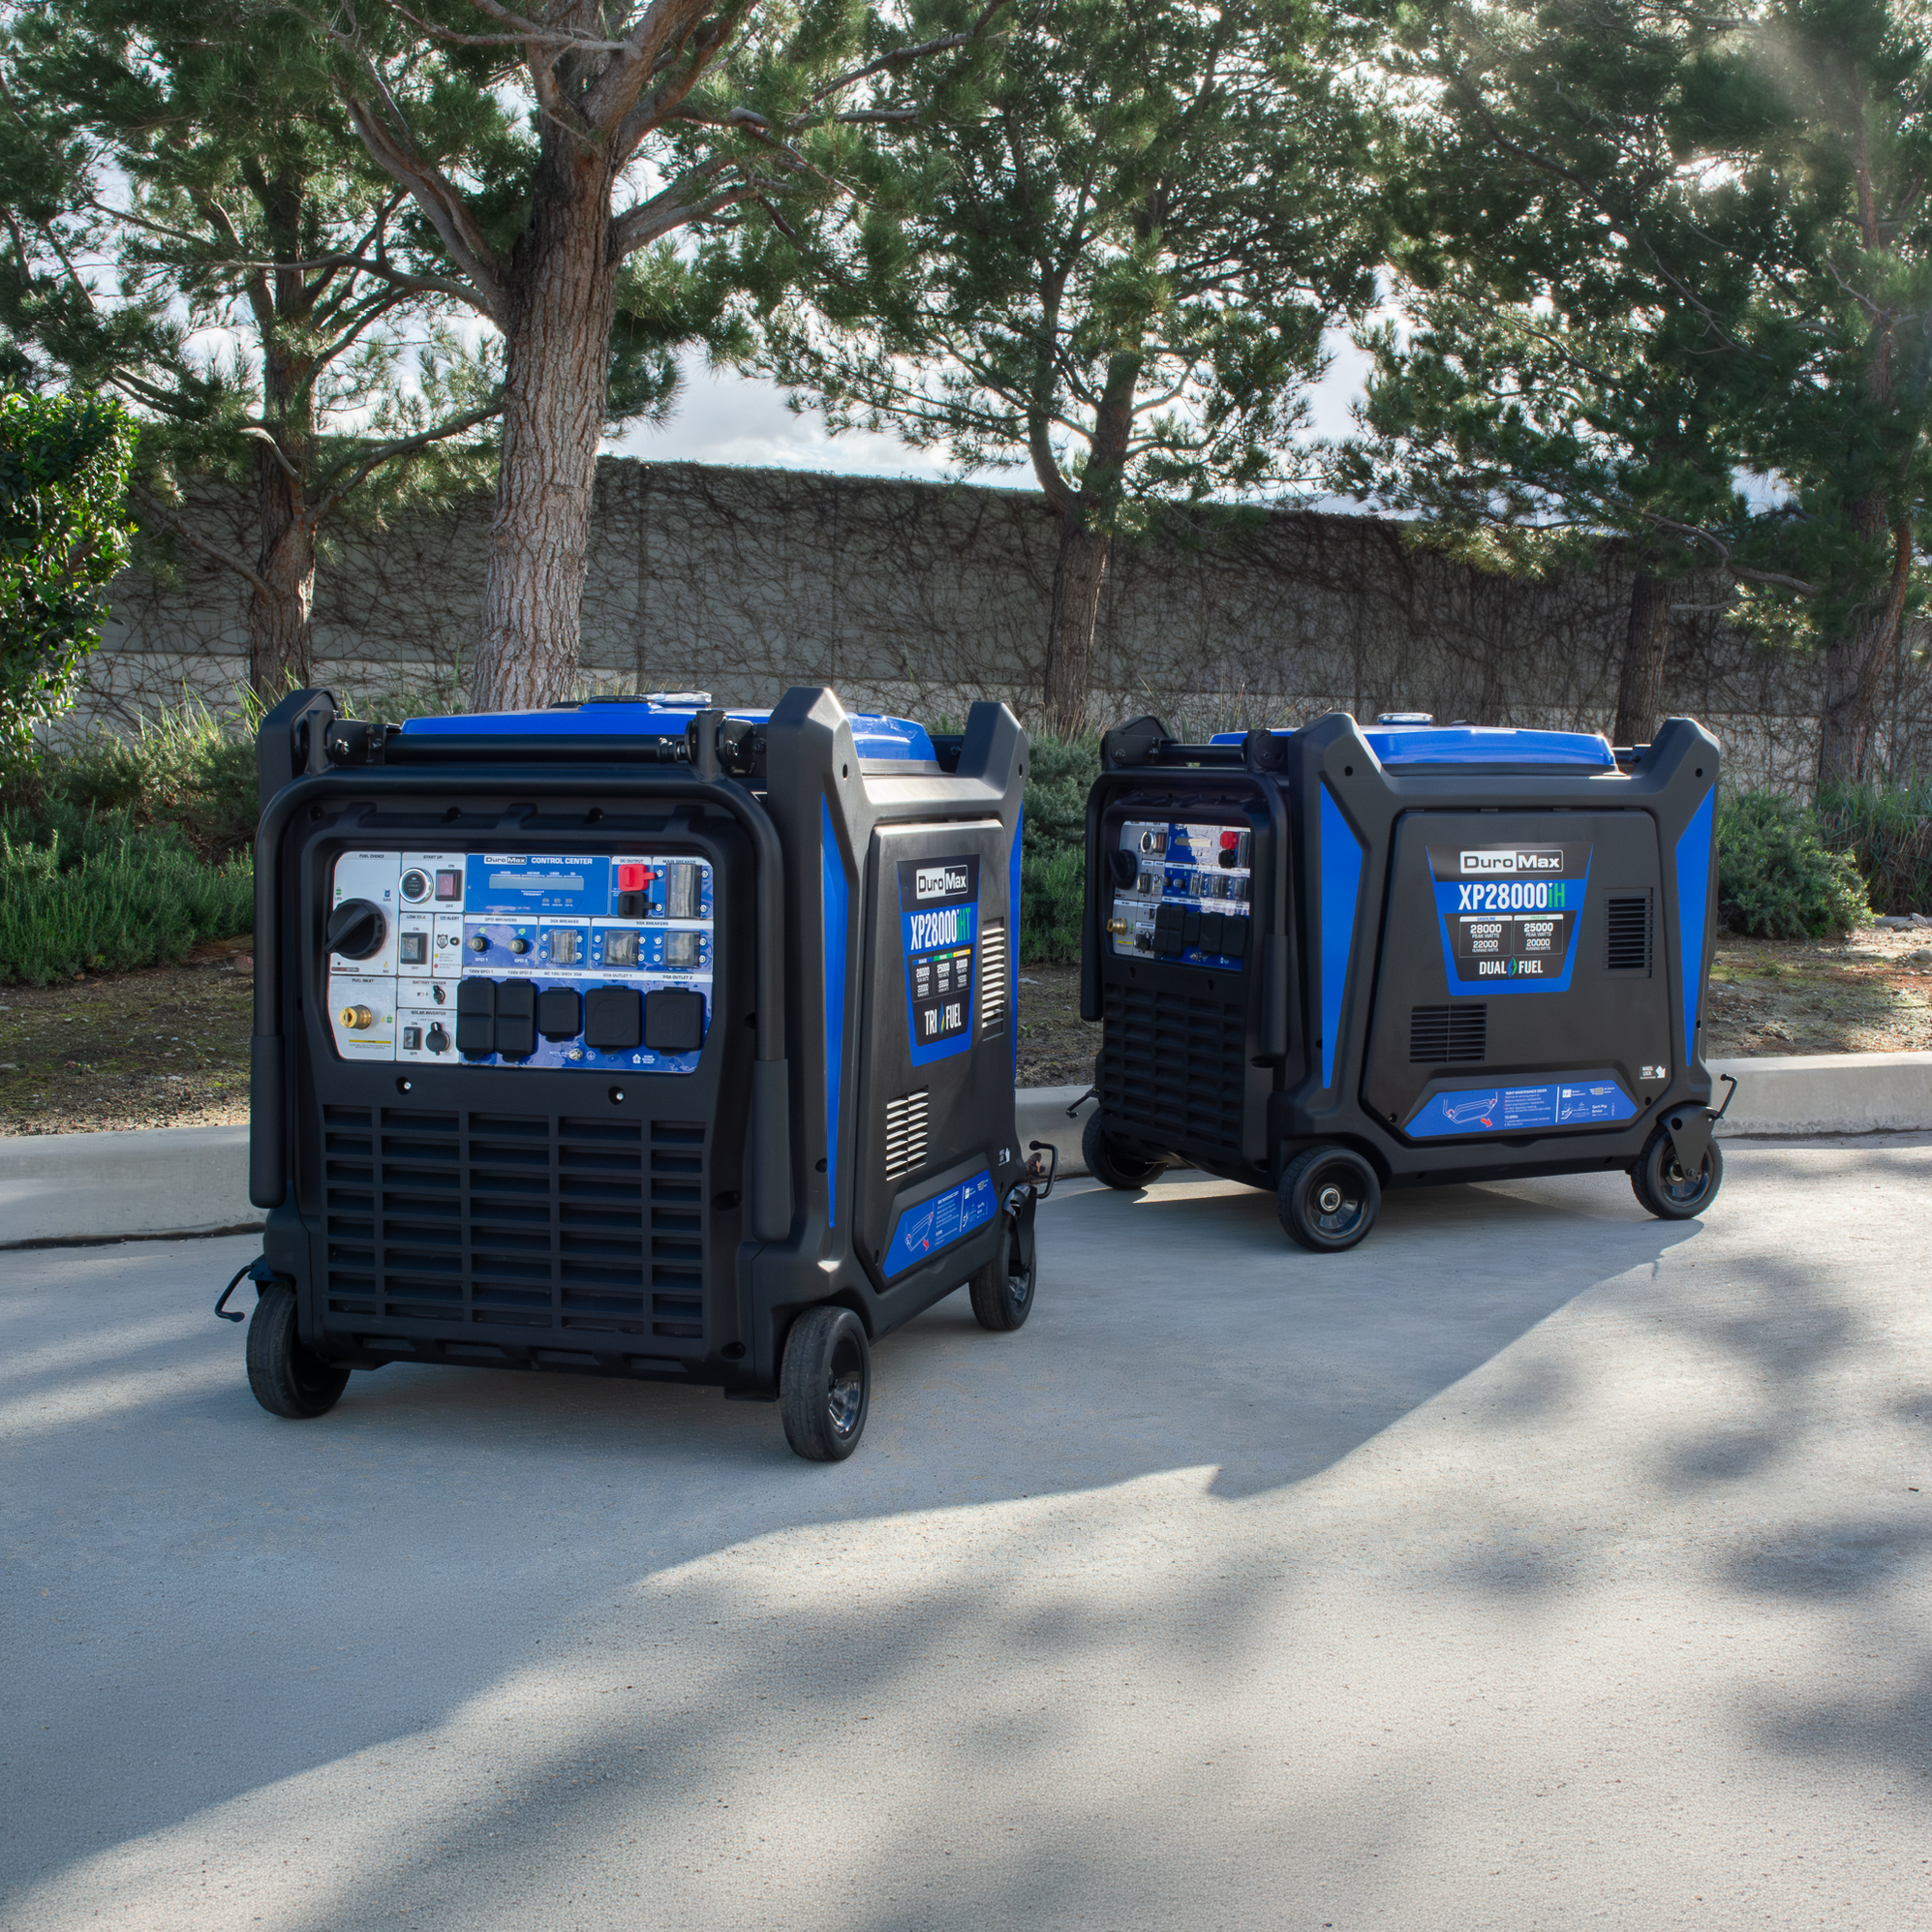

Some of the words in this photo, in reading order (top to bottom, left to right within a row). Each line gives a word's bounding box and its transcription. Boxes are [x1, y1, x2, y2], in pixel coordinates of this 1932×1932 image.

[1470, 924, 1502, 934] 28000
[1524, 922, 1553, 933] 25000
[1473, 939, 1499, 948] 22000
[1526, 938, 1550, 947] 20000
[1479, 961, 1507, 975] DUAL
[1518, 960, 1543, 974] FUEL
[924, 1008, 937, 1035] TRI
[945, 1002, 962, 1030] FUEL
